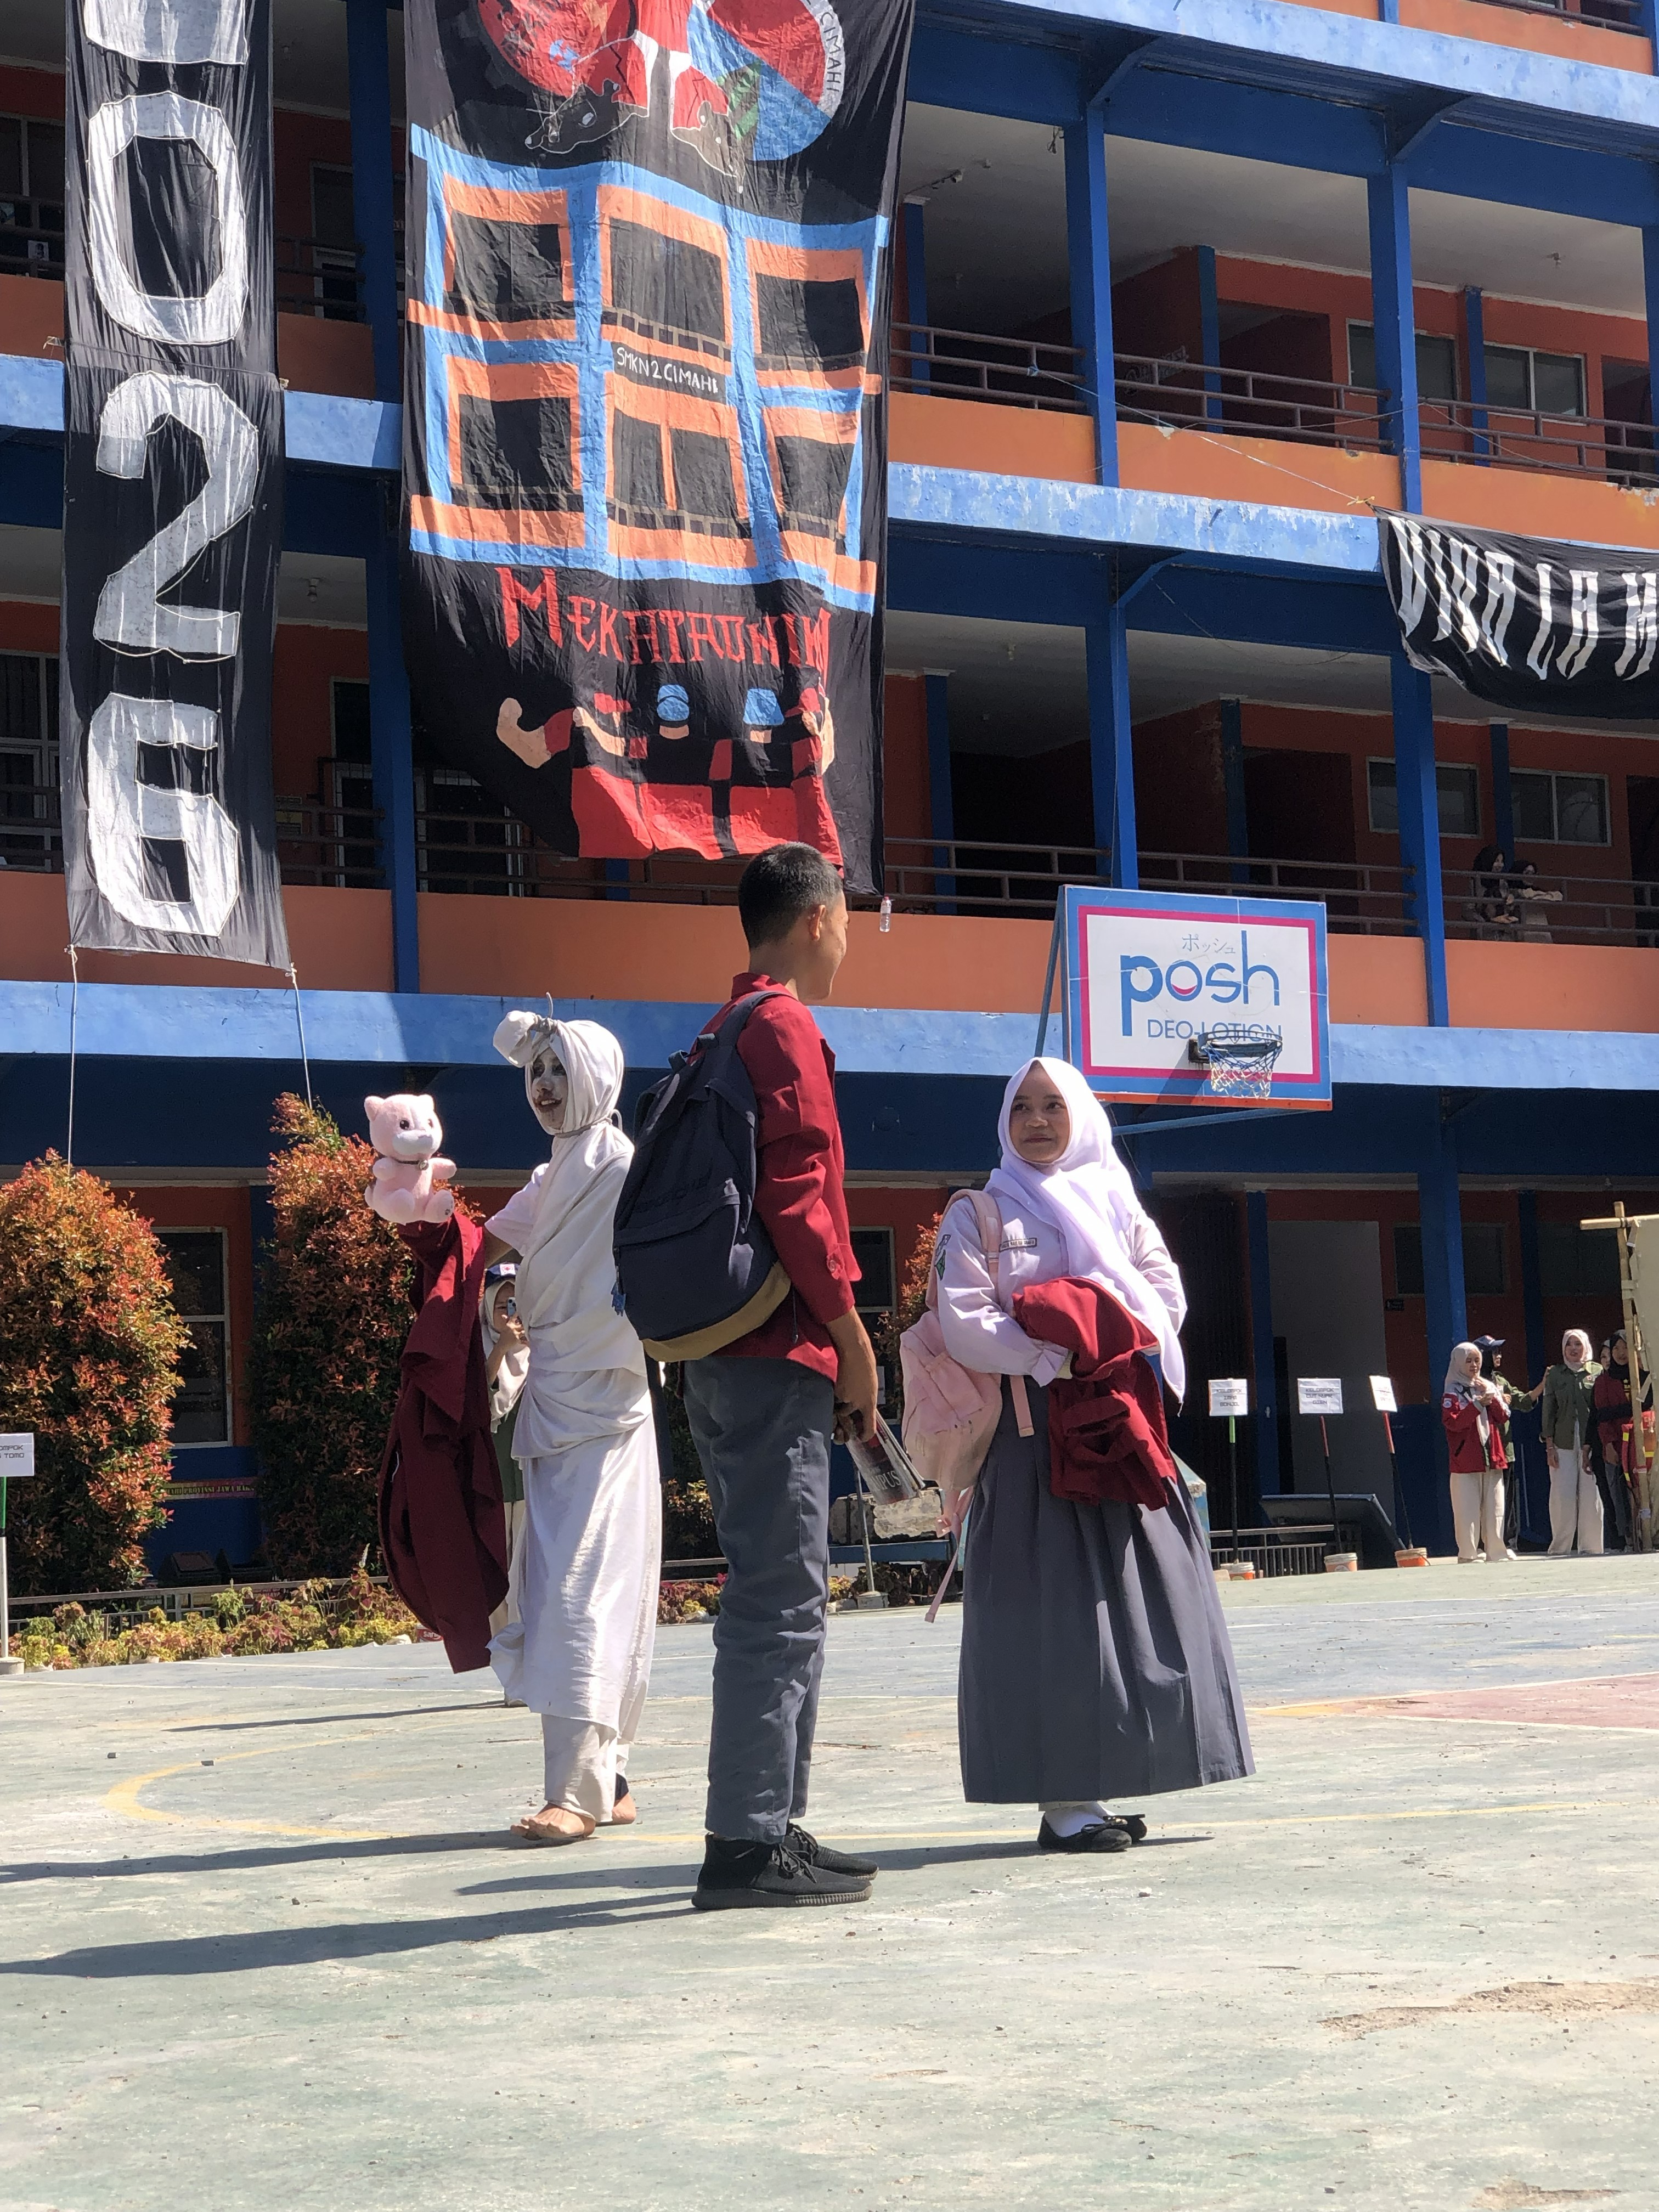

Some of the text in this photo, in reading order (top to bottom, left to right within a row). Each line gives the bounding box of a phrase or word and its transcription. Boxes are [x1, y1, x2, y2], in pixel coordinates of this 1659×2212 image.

[819, 12, 842, 93] CIMAHI
[84, 0, 258, 936] 026
[1120, 930, 1280, 1037] posh
[1182, 933, 1235, 954] ポッシュ
